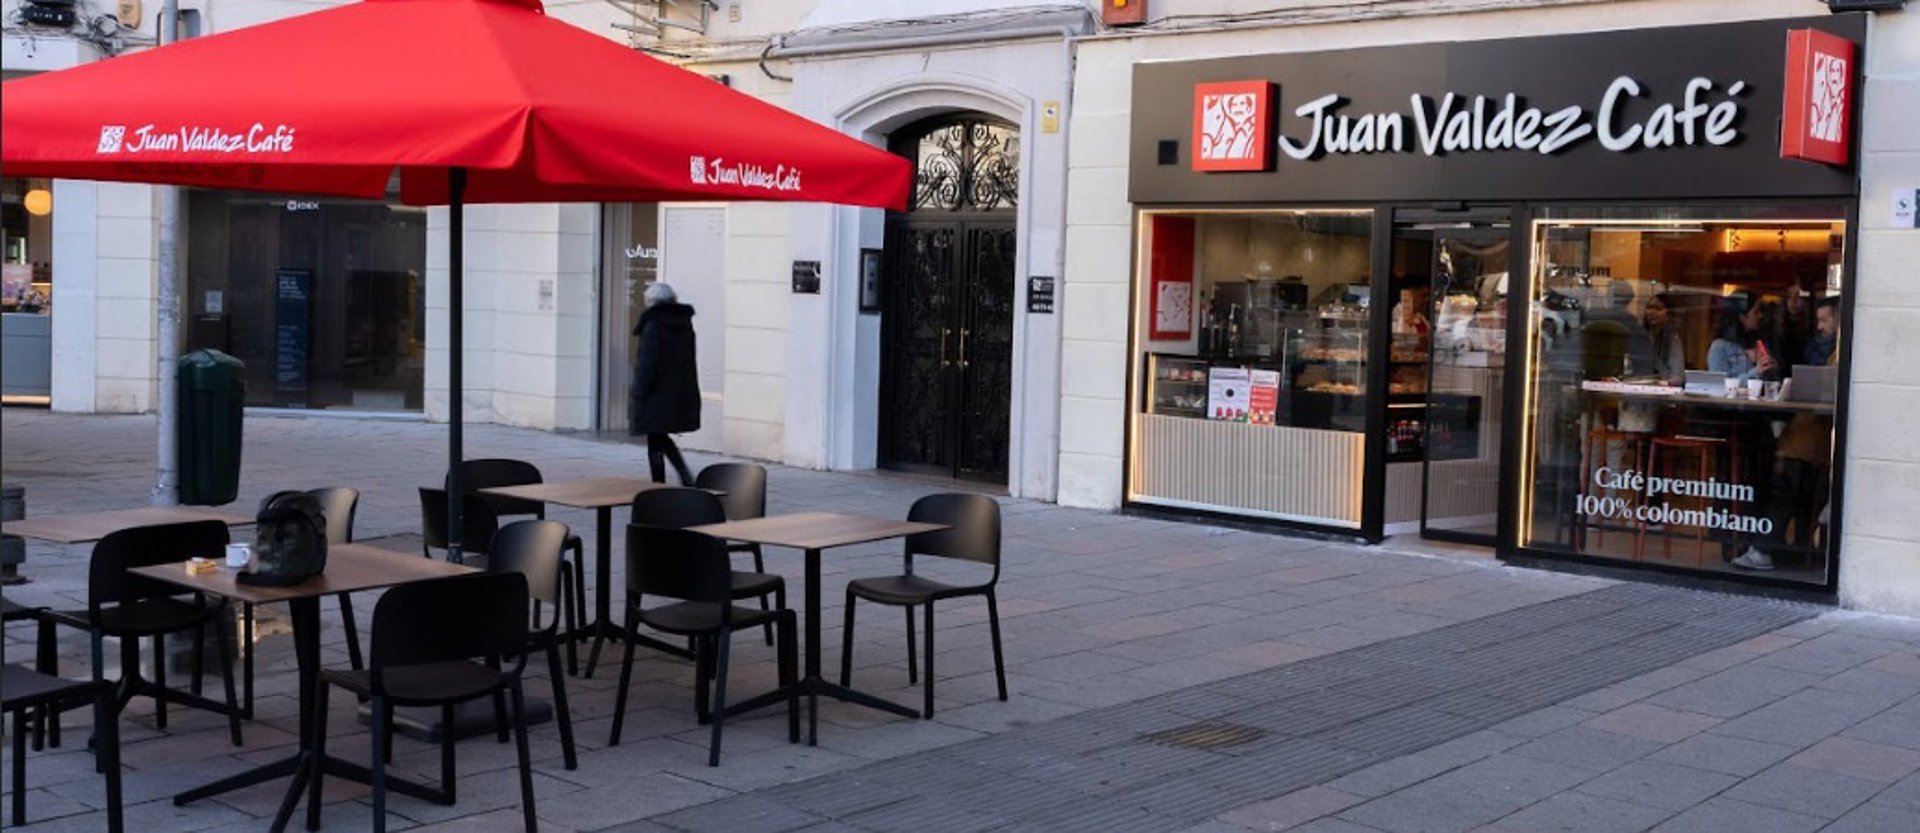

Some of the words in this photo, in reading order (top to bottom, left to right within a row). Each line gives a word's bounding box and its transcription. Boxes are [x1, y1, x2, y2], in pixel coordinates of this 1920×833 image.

[1278, 93, 1403, 160] Juan
[1410, 91, 1593, 156] Valdez
[1597, 75, 1745, 152] Café
[126, 124, 179, 153] Juan
[181, 126, 246, 153] Valdez
[247, 122, 295, 153] Café
[707, 157, 739, 184] Juan
[738, 162, 776, 190] Valdez
[775, 163, 801, 192] Café
[1594, 467, 1644, 491] Café
[1646, 476, 1754, 502] premium
[1575, 494, 1632, 520] 100%
[1635, 502, 1773, 534] colombiano
